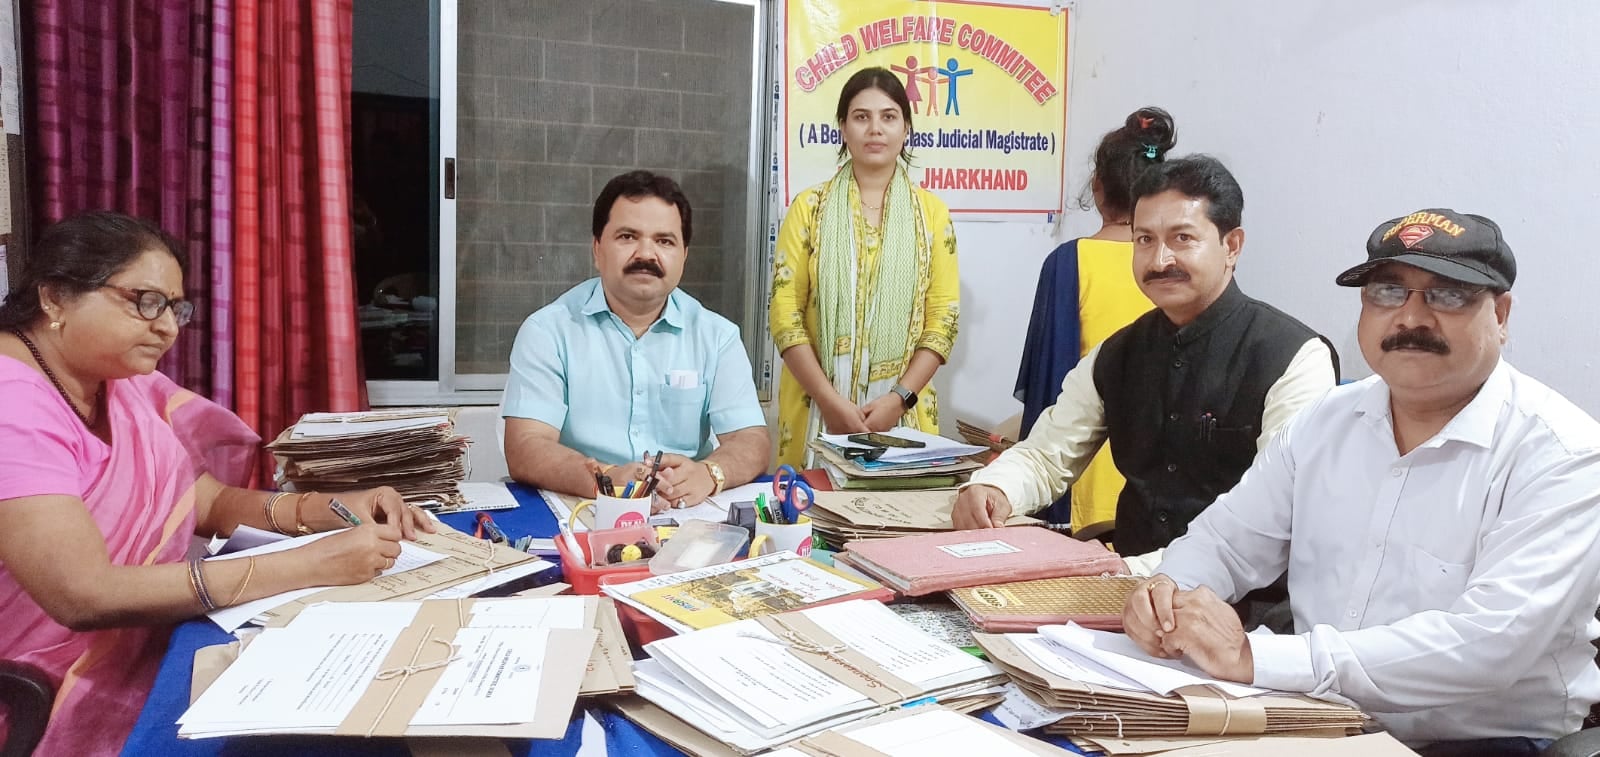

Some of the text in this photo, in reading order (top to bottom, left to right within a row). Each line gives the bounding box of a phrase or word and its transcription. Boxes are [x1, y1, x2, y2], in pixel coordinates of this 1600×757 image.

[795, 16, 1057, 104] CHILD WELFARE COMMITEE
[807, 123, 818, 144] A
[937, 128, 982, 149] Judicial
[985, 130, 1048, 154] Magistrate
[920, 168, 1028, 191] JHARKHAND
[1382, 211, 1466, 242] SUPERMAN
